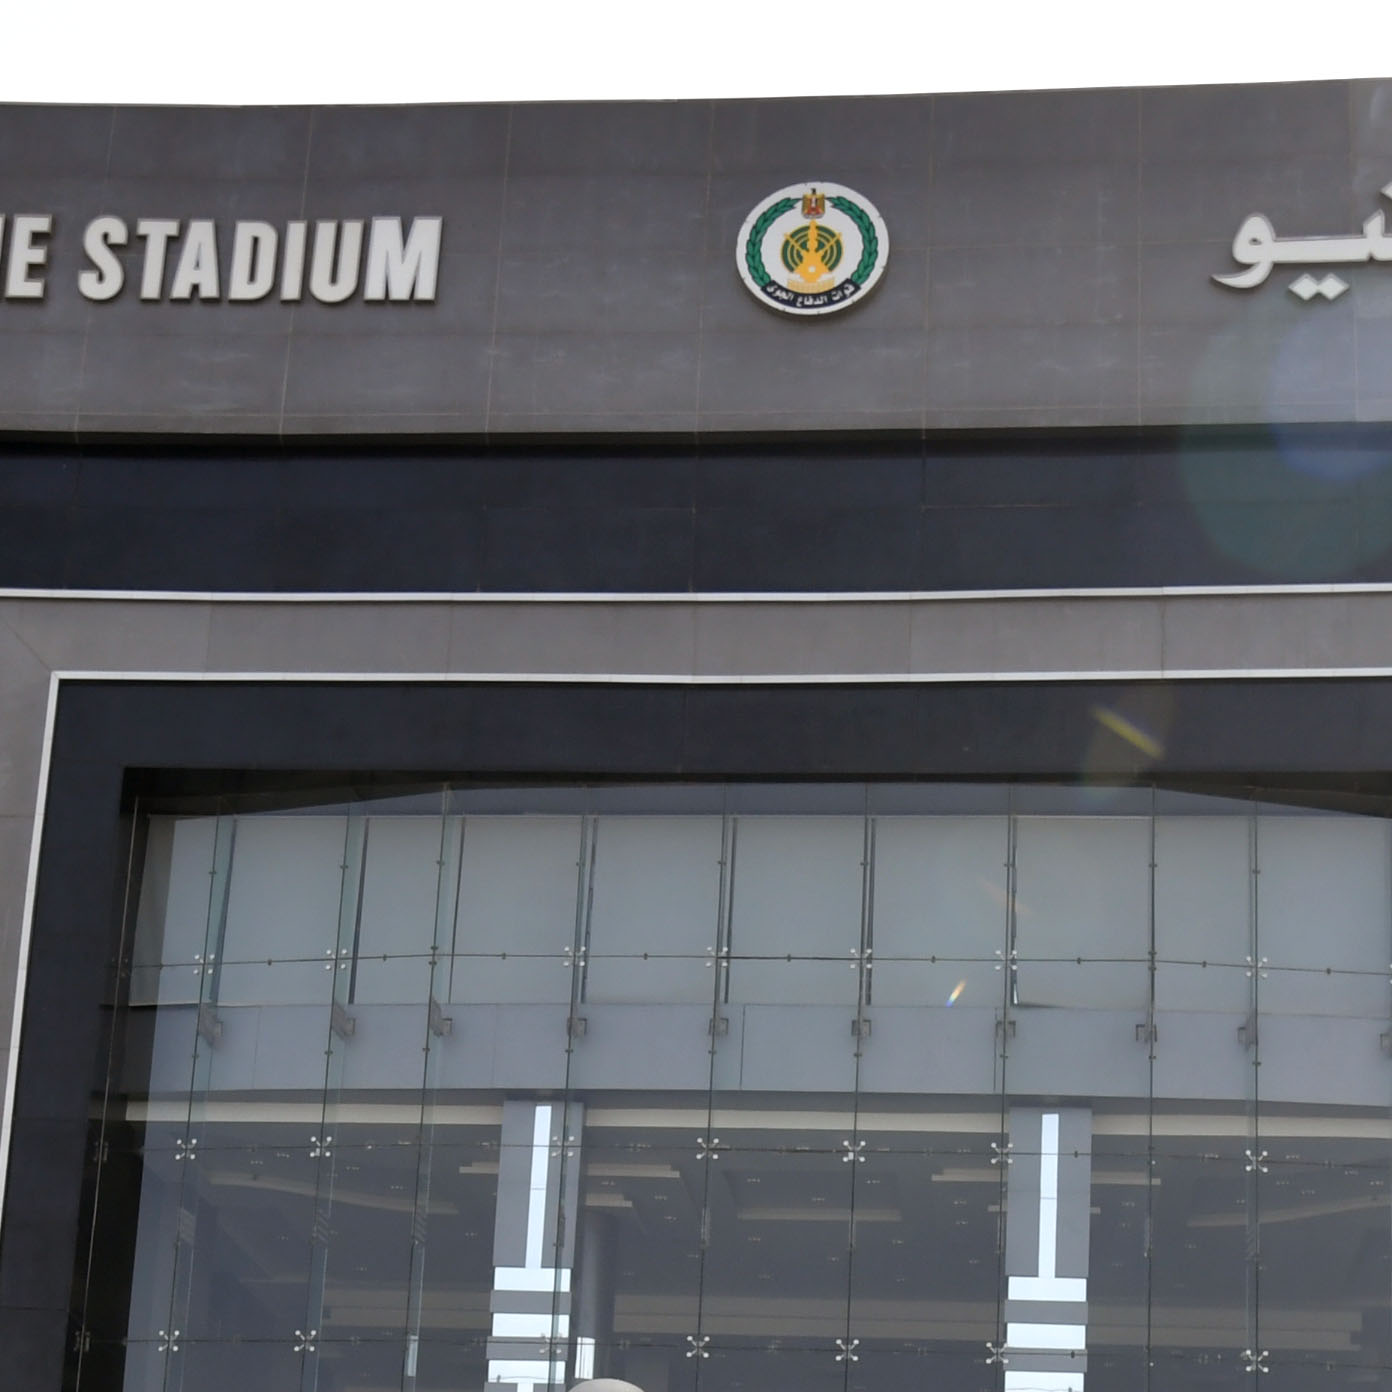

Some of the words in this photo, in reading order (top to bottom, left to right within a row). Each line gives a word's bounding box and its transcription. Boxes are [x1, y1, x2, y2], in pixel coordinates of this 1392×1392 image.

[77, 215, 443, 302] STADIUM
[795, 294, 829, 307] الدفاع
[831, 282, 856, 302] قوات
